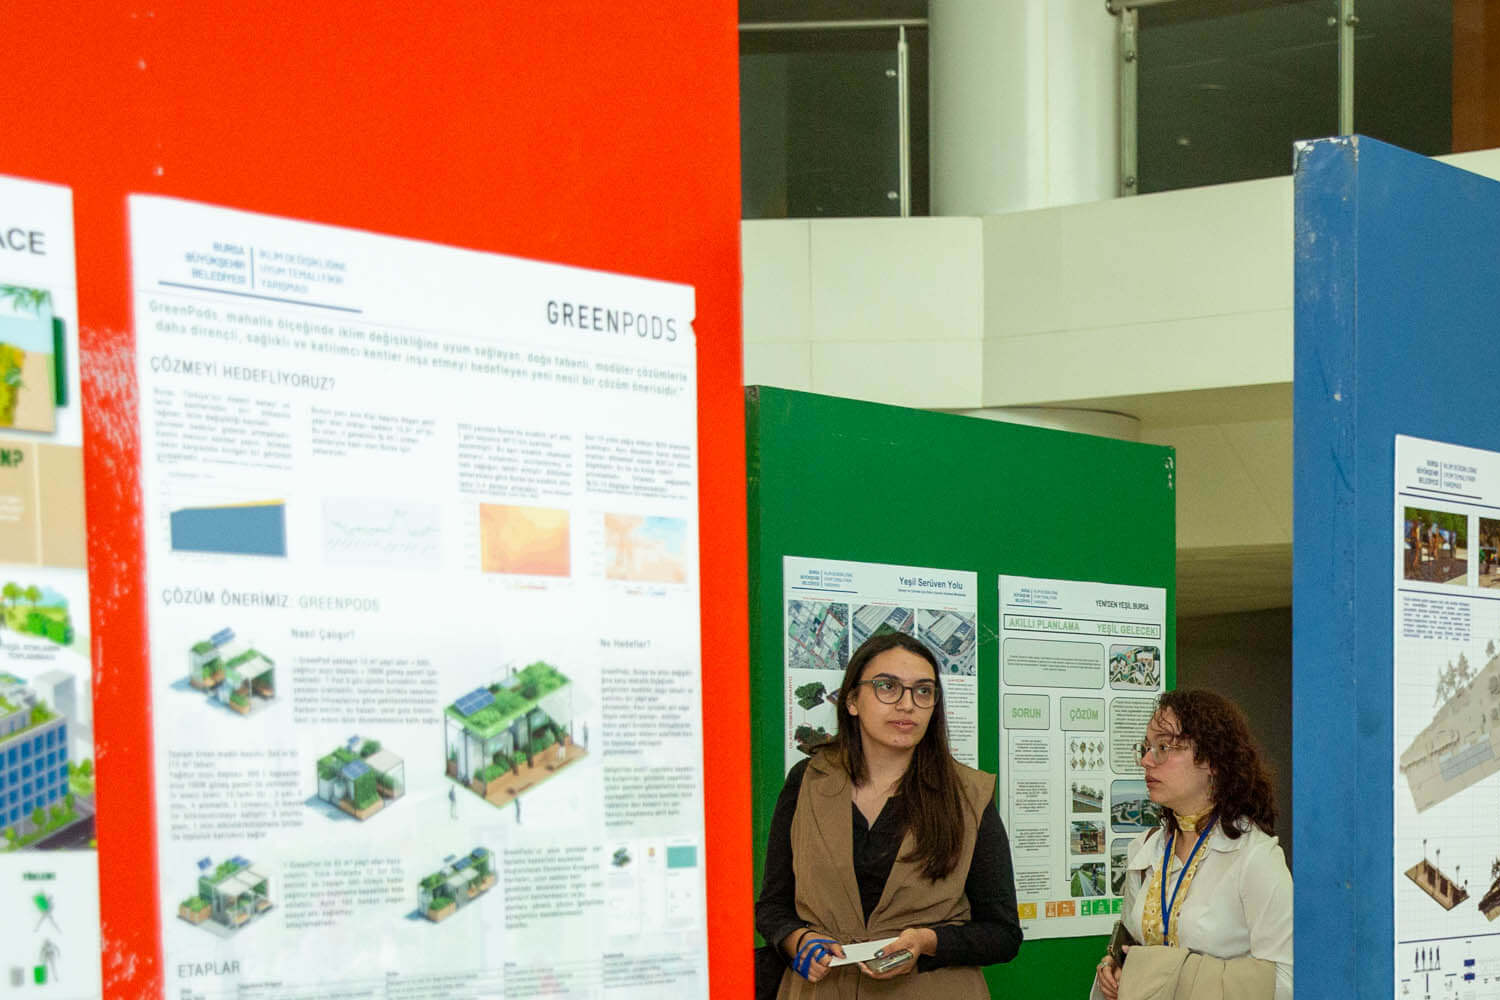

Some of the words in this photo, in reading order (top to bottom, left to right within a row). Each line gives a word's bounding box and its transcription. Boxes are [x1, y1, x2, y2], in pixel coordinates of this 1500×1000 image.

[547, 300, 679, 343] GREENPODS
[150, 355, 218, 376] ÇÖZMEYİ
[223, 365, 336, 391] HEDEFLİYORUZ?
[899, 576, 917, 588] Yeşil
[918, 577, 946, 590] Serüven
[947, 580, 964, 591] Yolu
[162, 586, 215, 607] ÇÖZÜM
[1037, 619, 1080, 631] PLANLAMA
[1097, 623, 1119, 635] YEŞİL
[1070, 708, 1099, 721] ÇÖZÜM
[178, 960, 240, 978] ETAPLAR
